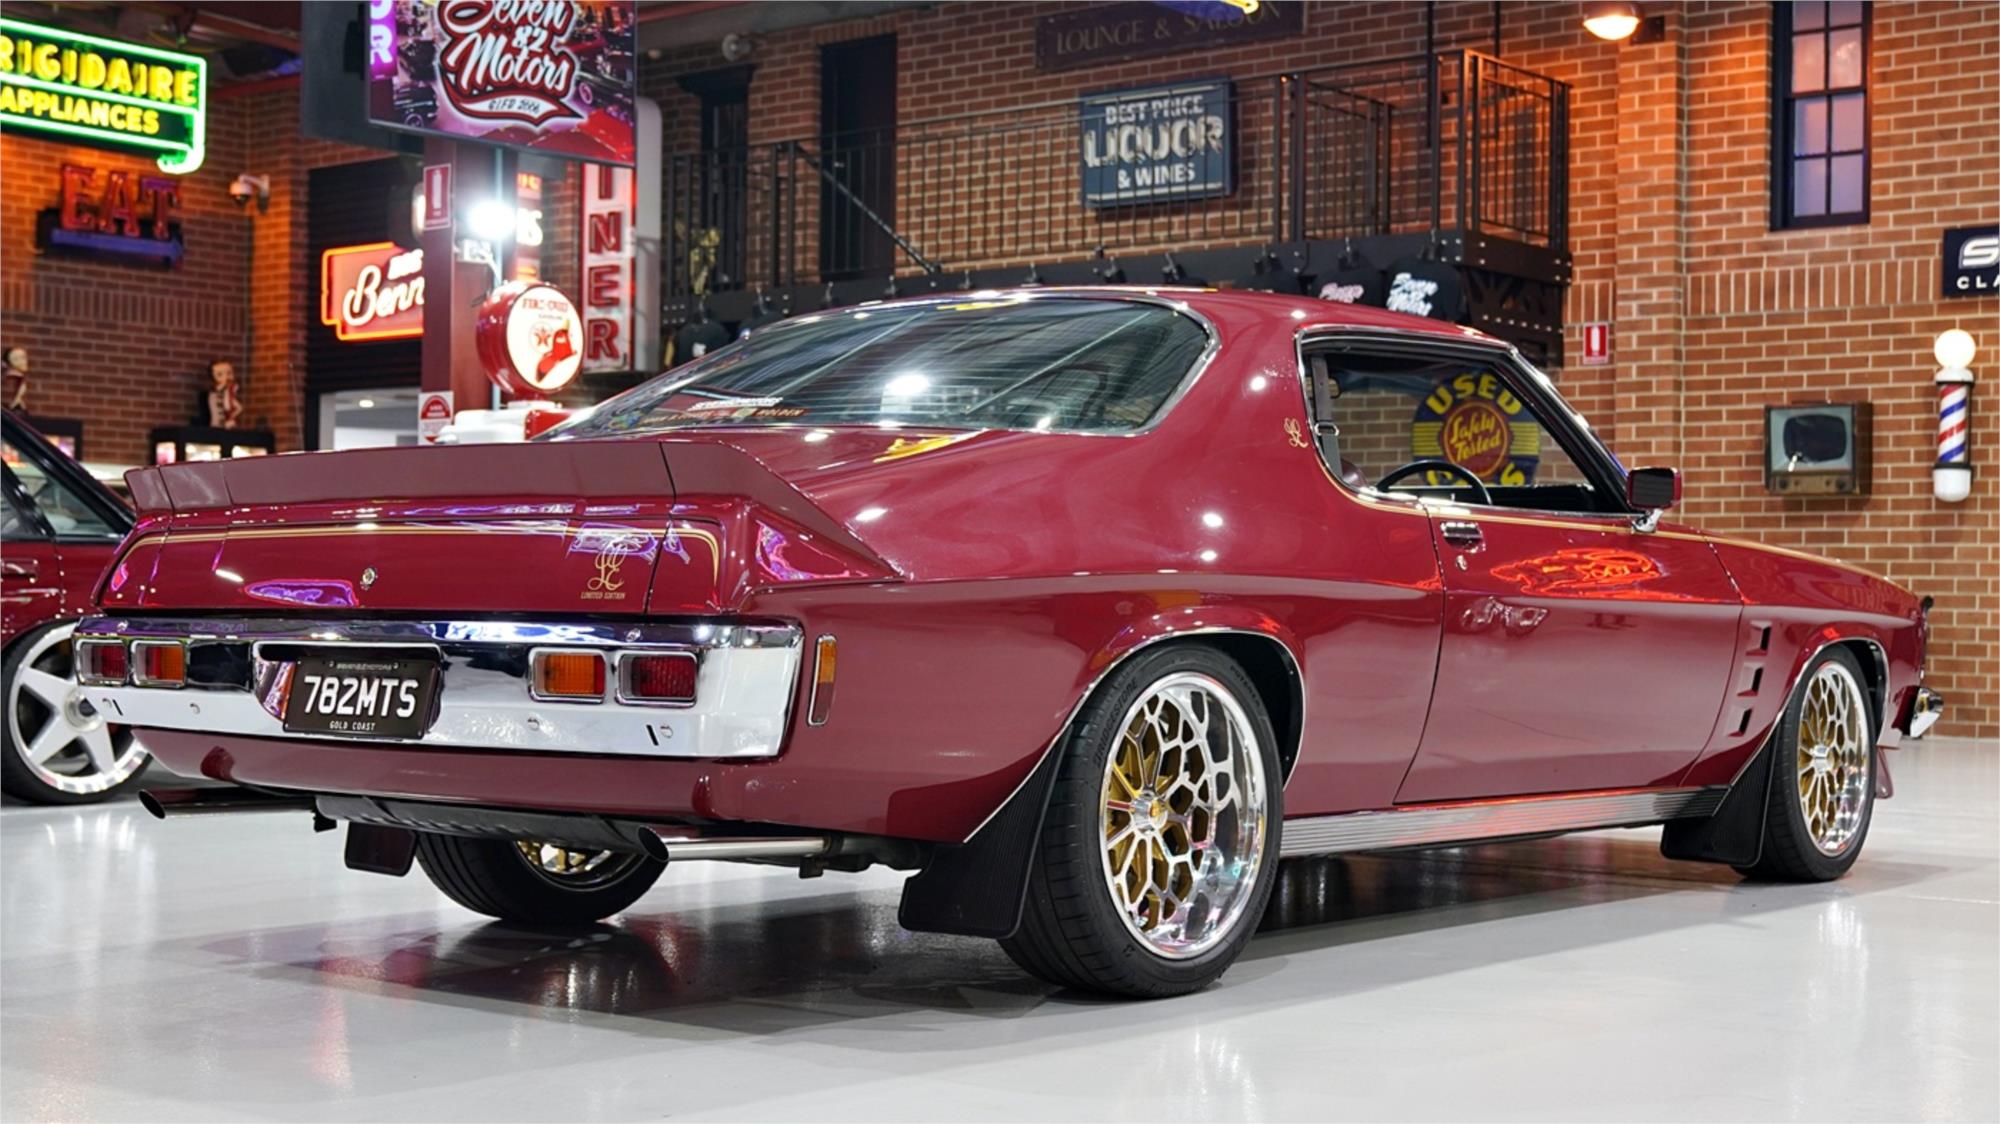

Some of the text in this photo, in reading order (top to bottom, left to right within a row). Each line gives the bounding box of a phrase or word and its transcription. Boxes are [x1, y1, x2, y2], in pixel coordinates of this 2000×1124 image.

[512, 25, 548, 52] 82
[1056, 19, 1145, 55] LOUNGE
[1153, 19, 1171, 40] &
[447, 32, 570, 92] Motors
[0, 86, 160, 135] APPLIANCES
[1105, 95, 1203, 125] BEST PRICE
[1084, 115, 1224, 168] LIQUOR
[1118, 162, 1196, 189] & WINES
[61, 166, 180, 240] EAT
[1426, 373, 1522, 415] USED
[1451, 412, 1496, 444] Safety
[1455, 428, 1501, 463] Tested
[304, 675, 419, 718] 782MTS
[329, 720, 376, 731] GOLD COAST
[1092, 675, 1138, 769] BRIDGESTONE
